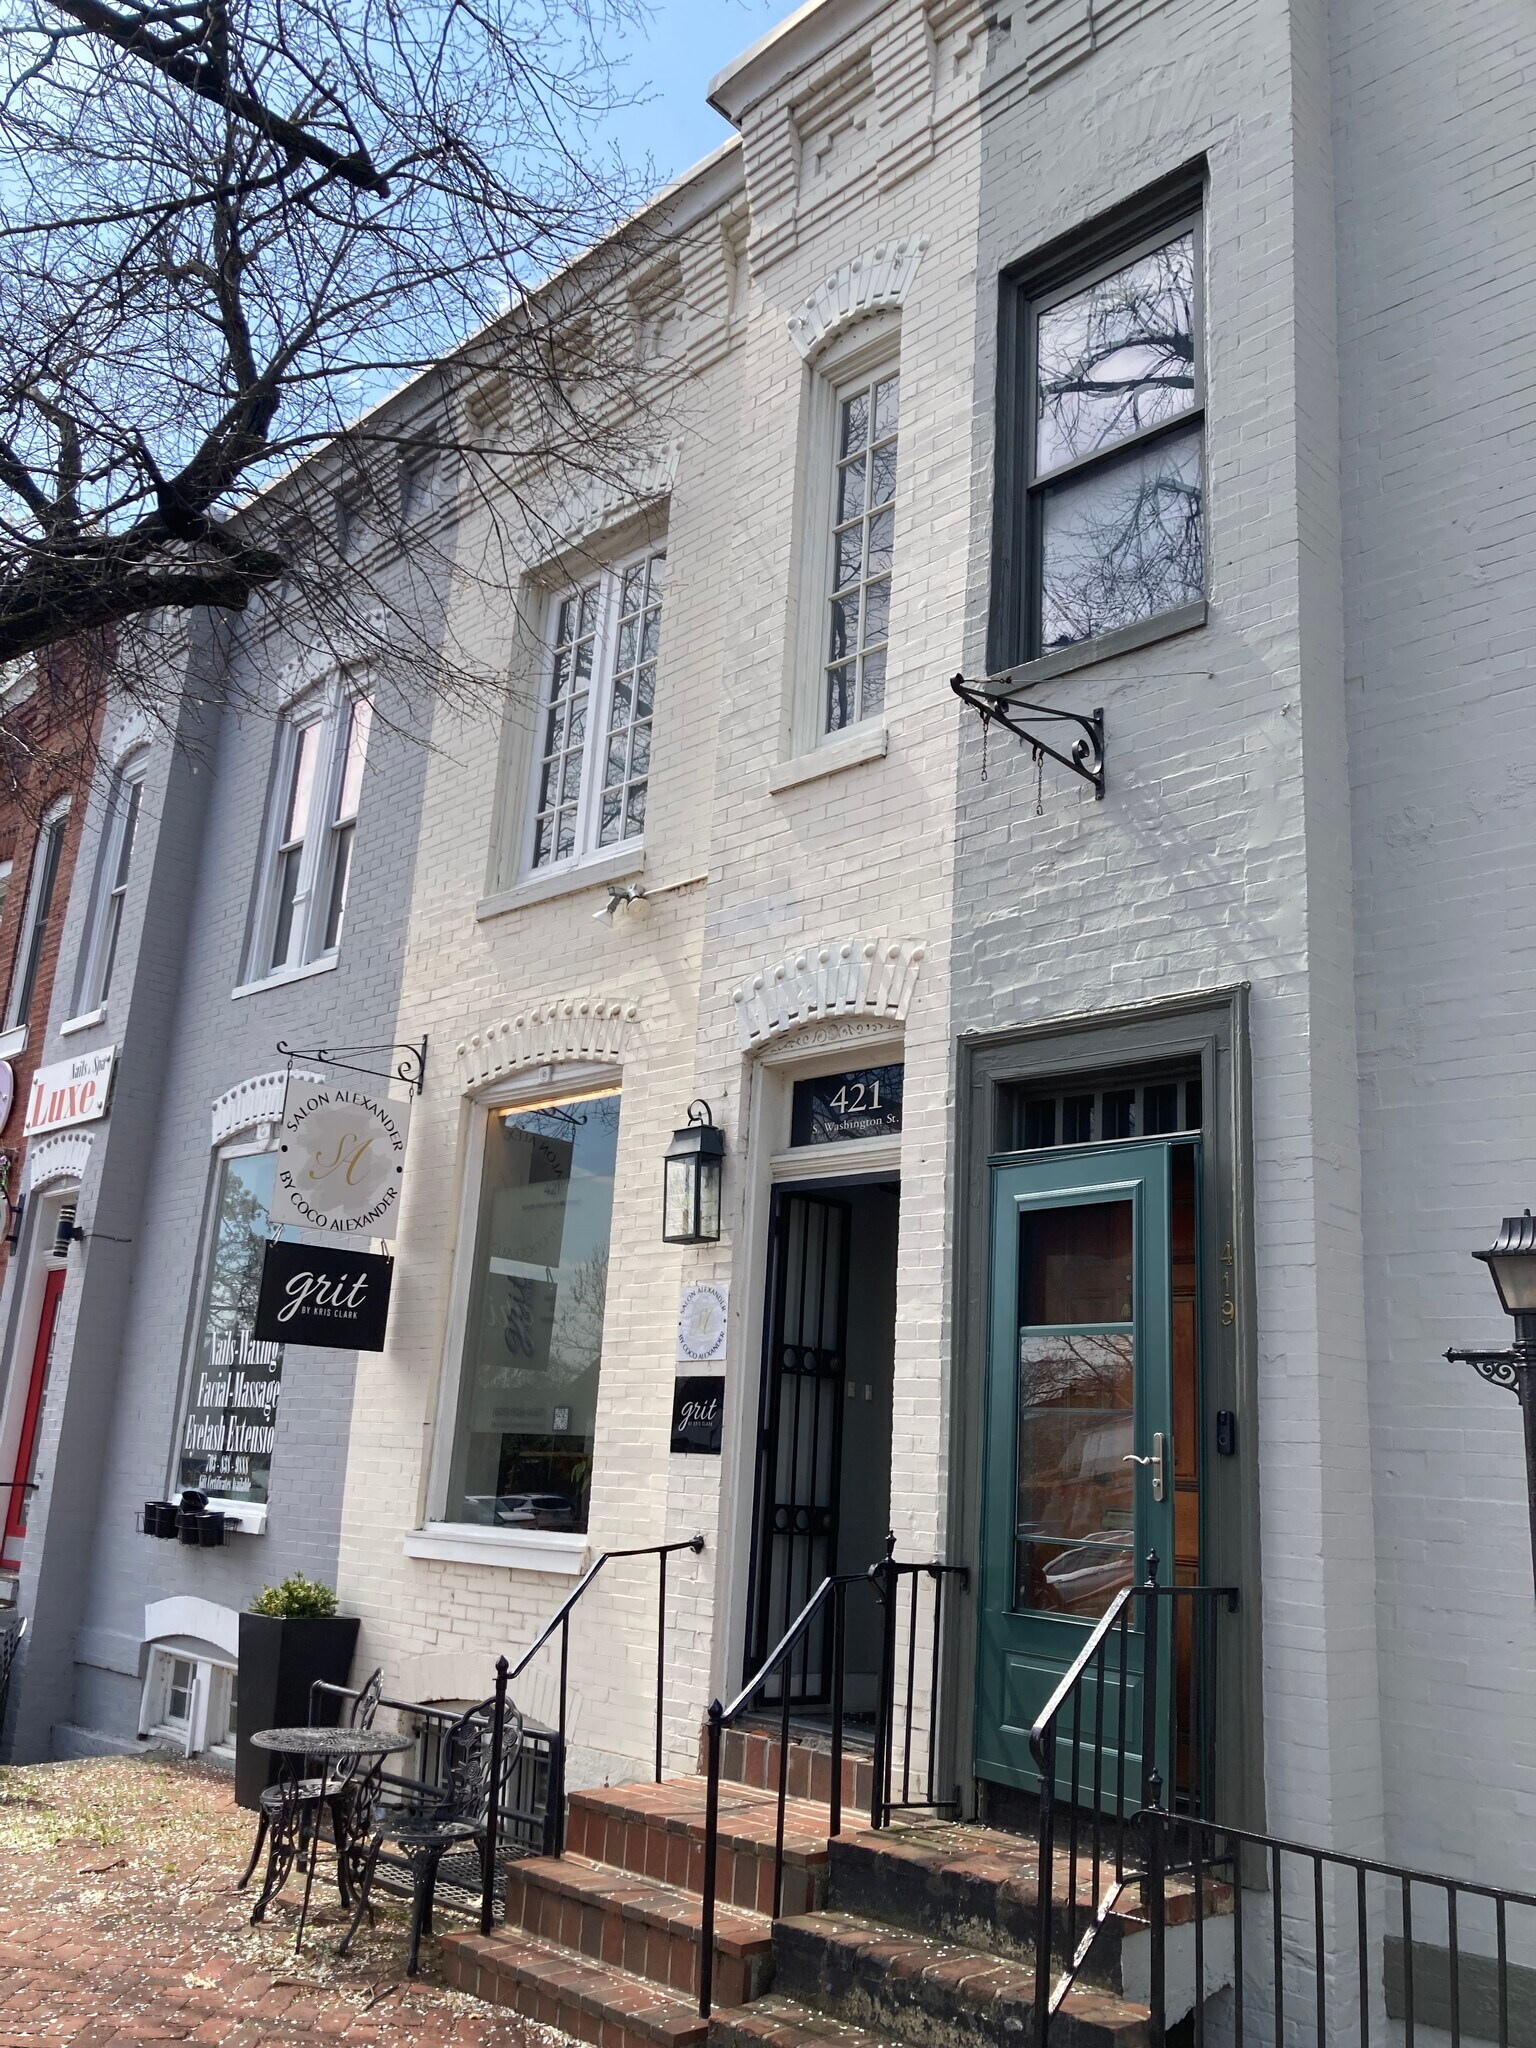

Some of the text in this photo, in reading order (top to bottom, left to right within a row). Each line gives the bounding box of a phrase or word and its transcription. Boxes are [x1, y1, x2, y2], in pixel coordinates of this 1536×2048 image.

[92, 1056, 107, 1076] Spa
[31, 1080, 96, 1127] Luxe
[829, 1080, 882, 1114] 421
[287, 1090, 403, 1151] SALON ALEXANDER
[812, 1113, 899, 1134] S. Washington St.
[280, 1170, 398, 1232] BY COCO ALEXANDER
[277, 1271, 369, 1322] grit
[302, 1306, 358, 1319] BY KRIS CLARK
[680, 1286, 726, 1314] SALON ALEXANDER
[678, 1331, 725, 1360] BY COCO ALEXANDER
[196, 1371, 281, 1417] Facial-Massage
[678, 1398, 718, 1432] grit
[184, 1414, 226, 1458] Eyelash
